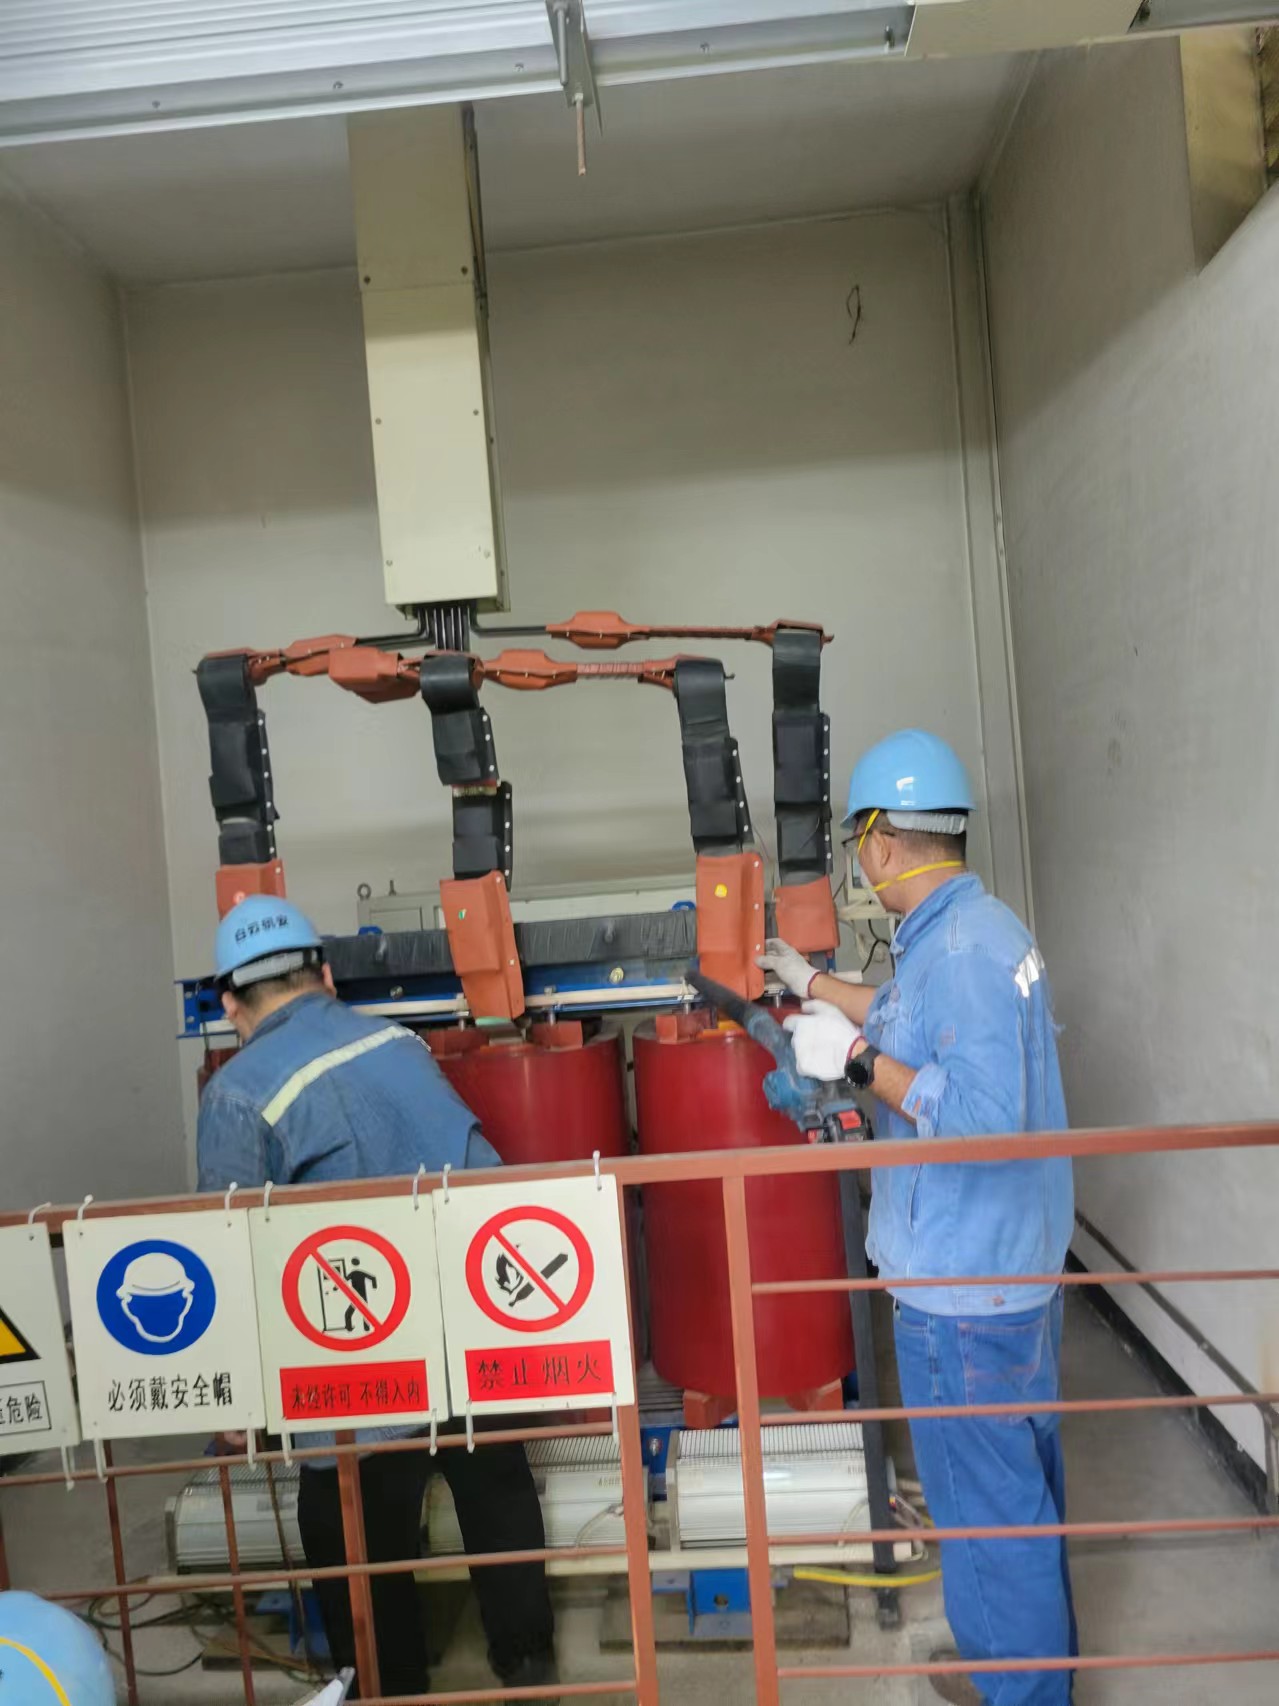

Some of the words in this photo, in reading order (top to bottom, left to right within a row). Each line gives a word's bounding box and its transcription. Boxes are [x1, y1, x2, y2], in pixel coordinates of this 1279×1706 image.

[478, 1353, 601, 1391] 禁止烟火
[108, 1372, 232, 1411] 必须戴安全帽
